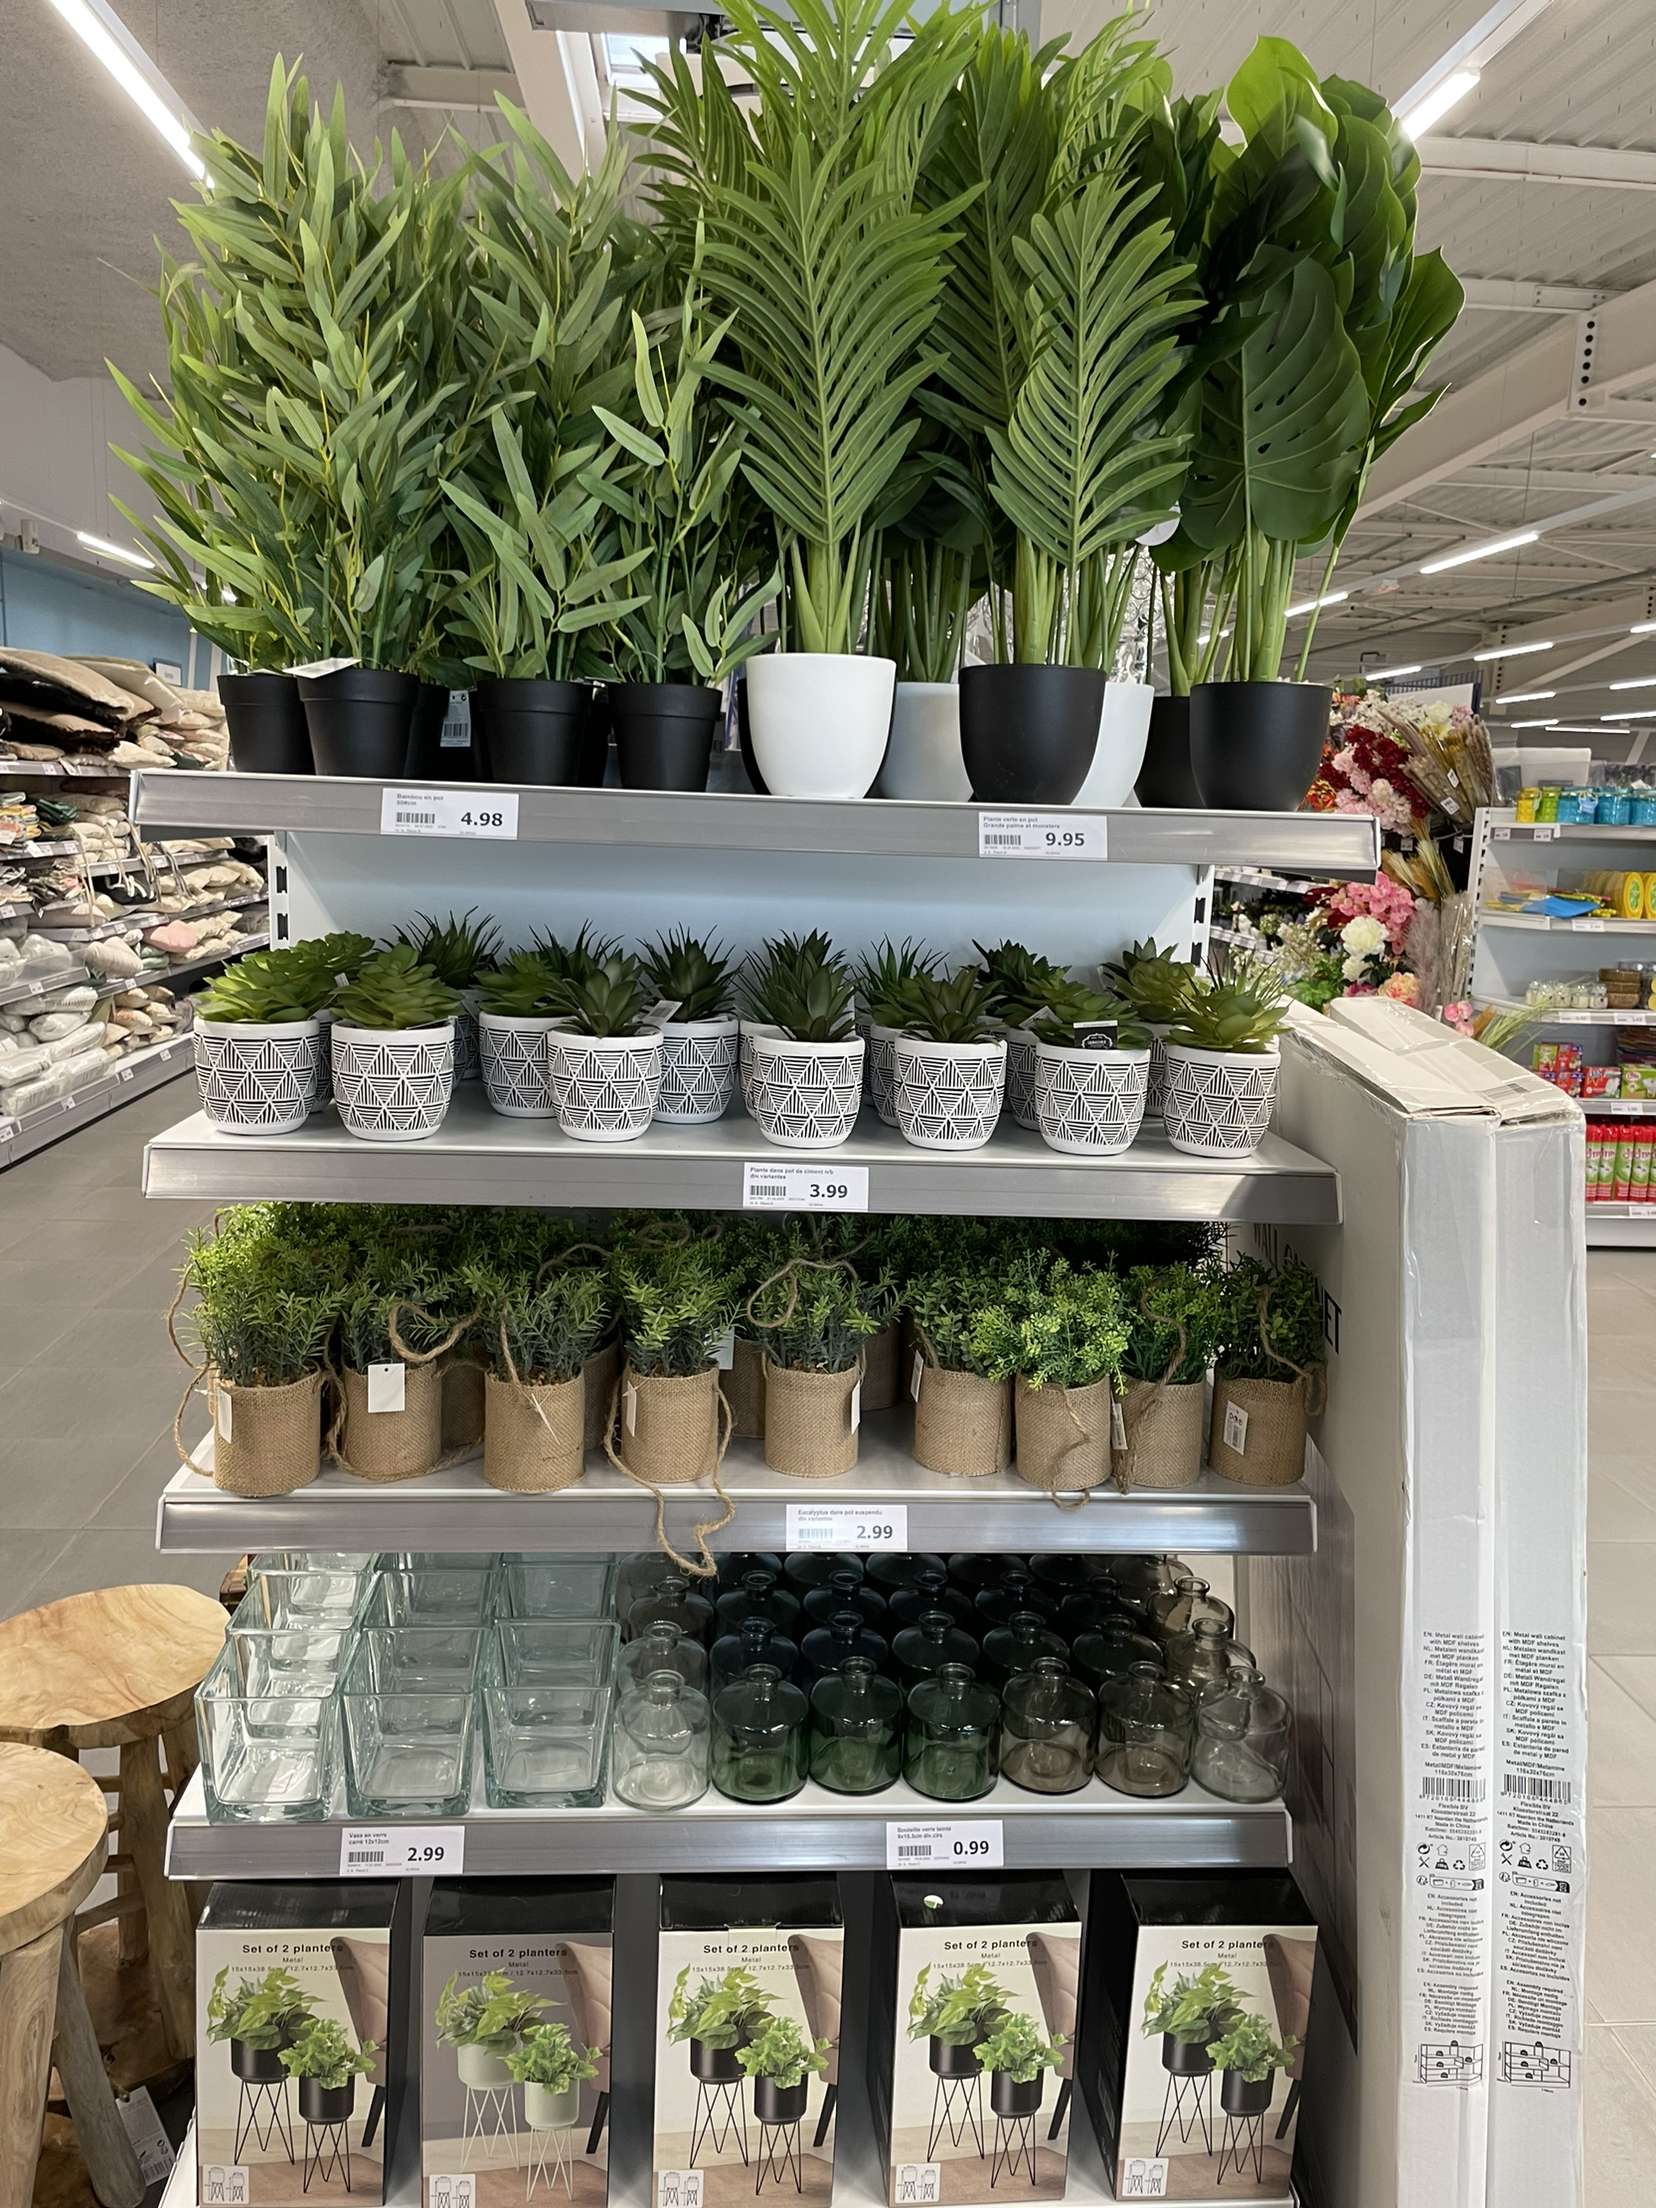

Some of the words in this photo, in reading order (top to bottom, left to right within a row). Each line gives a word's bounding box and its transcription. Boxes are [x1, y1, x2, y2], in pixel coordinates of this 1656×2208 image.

[460, 811, 503, 827] 4.98
[1045, 832, 1085, 846] 9.95
[809, 1184, 848, 1198] 3.99
[856, 1525, 893, 1539] 2.99
[407, 1846, 445, 1862] 2.99
[953, 1840, 989, 1855] 0.99
[242, 1944, 262, 1954] Set
[266, 1944, 278, 1953] of
[282, 1944, 289, 1953] 2
[703, 1944, 722, 1954] Set
[726, 1943, 738, 1953] of
[741, 1944, 750, 1953] 2
[944, 1941, 962, 1951] Set
[966, 1940, 978, 1950] of
[981, 1940, 988, 1949] 2
[991, 1940, 1038, 1951] planters
[1181, 1940, 1200, 1949] Set
[1203, 1939, 1216, 1949] of
[1218, 1940, 1225, 1949] 2
[469, 1949, 489, 1959] Set
[492, 1948, 504, 1958] of
[508, 1948, 515, 1957] 2
[519, 1948, 568, 1958] planters
